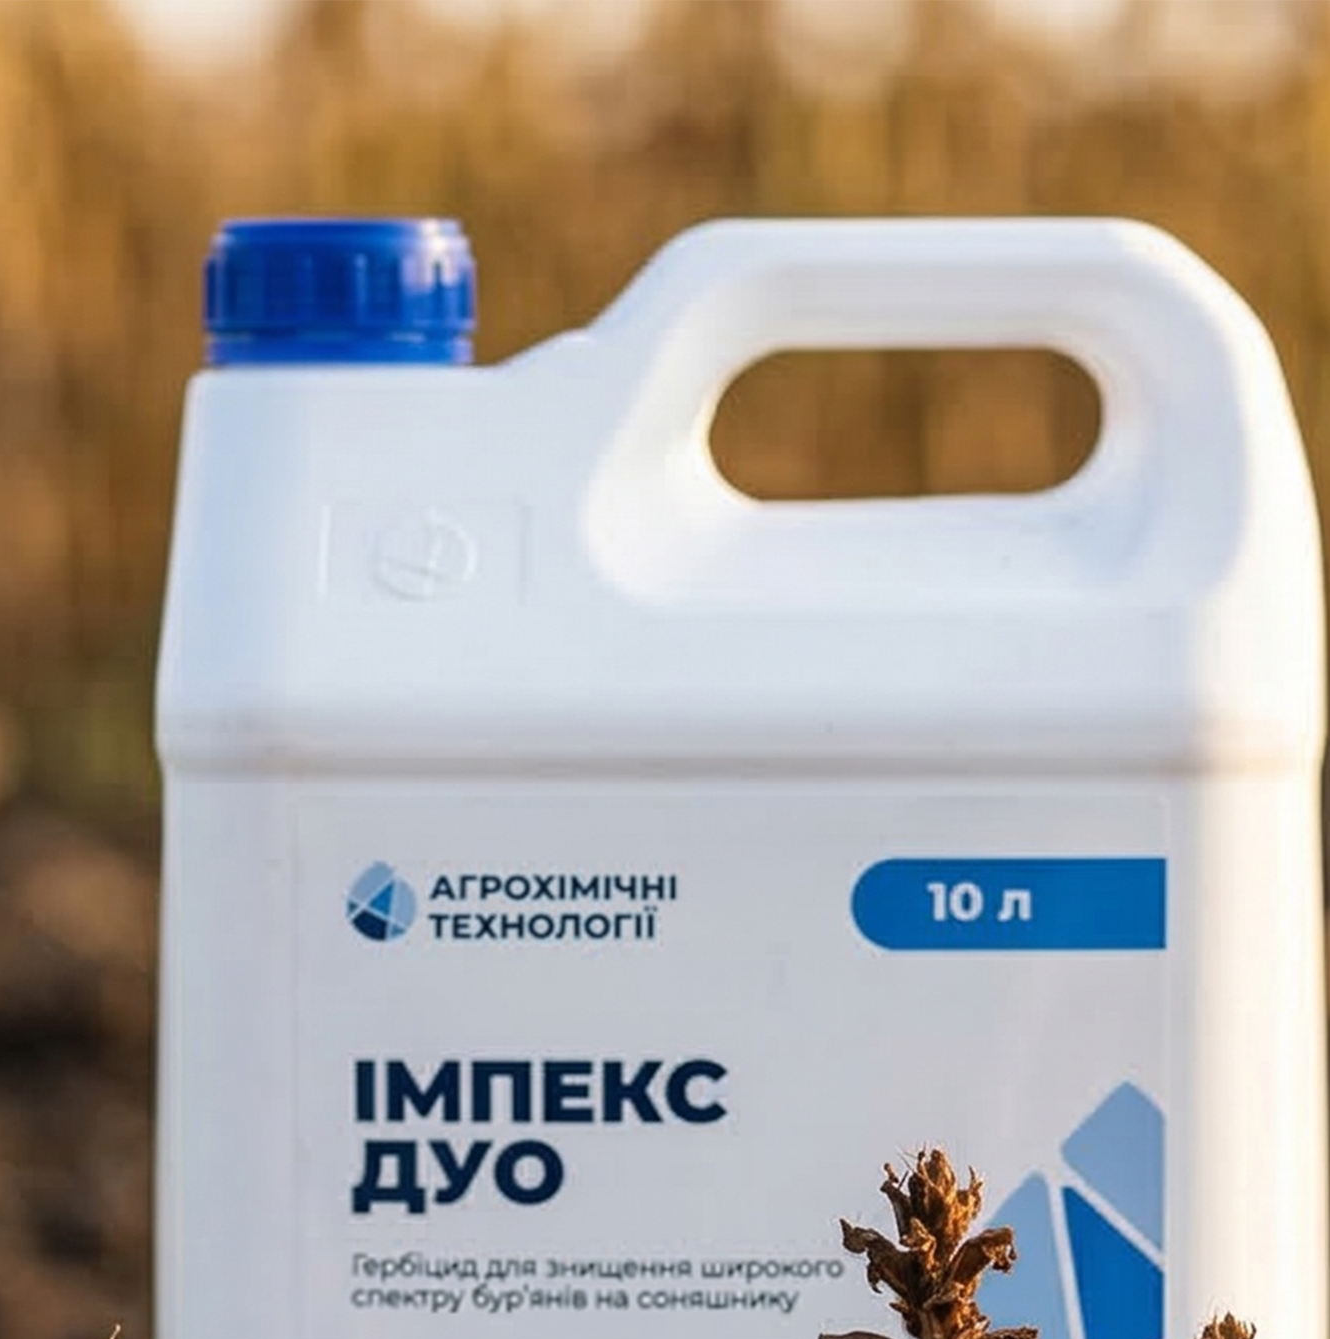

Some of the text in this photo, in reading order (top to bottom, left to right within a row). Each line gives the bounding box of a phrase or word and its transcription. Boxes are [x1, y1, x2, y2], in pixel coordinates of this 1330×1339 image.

[429, 874, 677, 902] АГРОХІМІЧНІ
[928, 882, 1032, 922] 10 л
[427, 904, 658, 941] ТЕХНОЛОГІЇ
[355, 1059, 727, 1124] ІМПЕКС
[350, 1138, 565, 1216] ДУО
[352, 1253, 845, 1284] Гербіцид для знищення широкого
[351, 1288, 464, 1314] спектру
[596, 1289, 629, 1310] на
[637, 1289, 800, 1315] соняшнику
